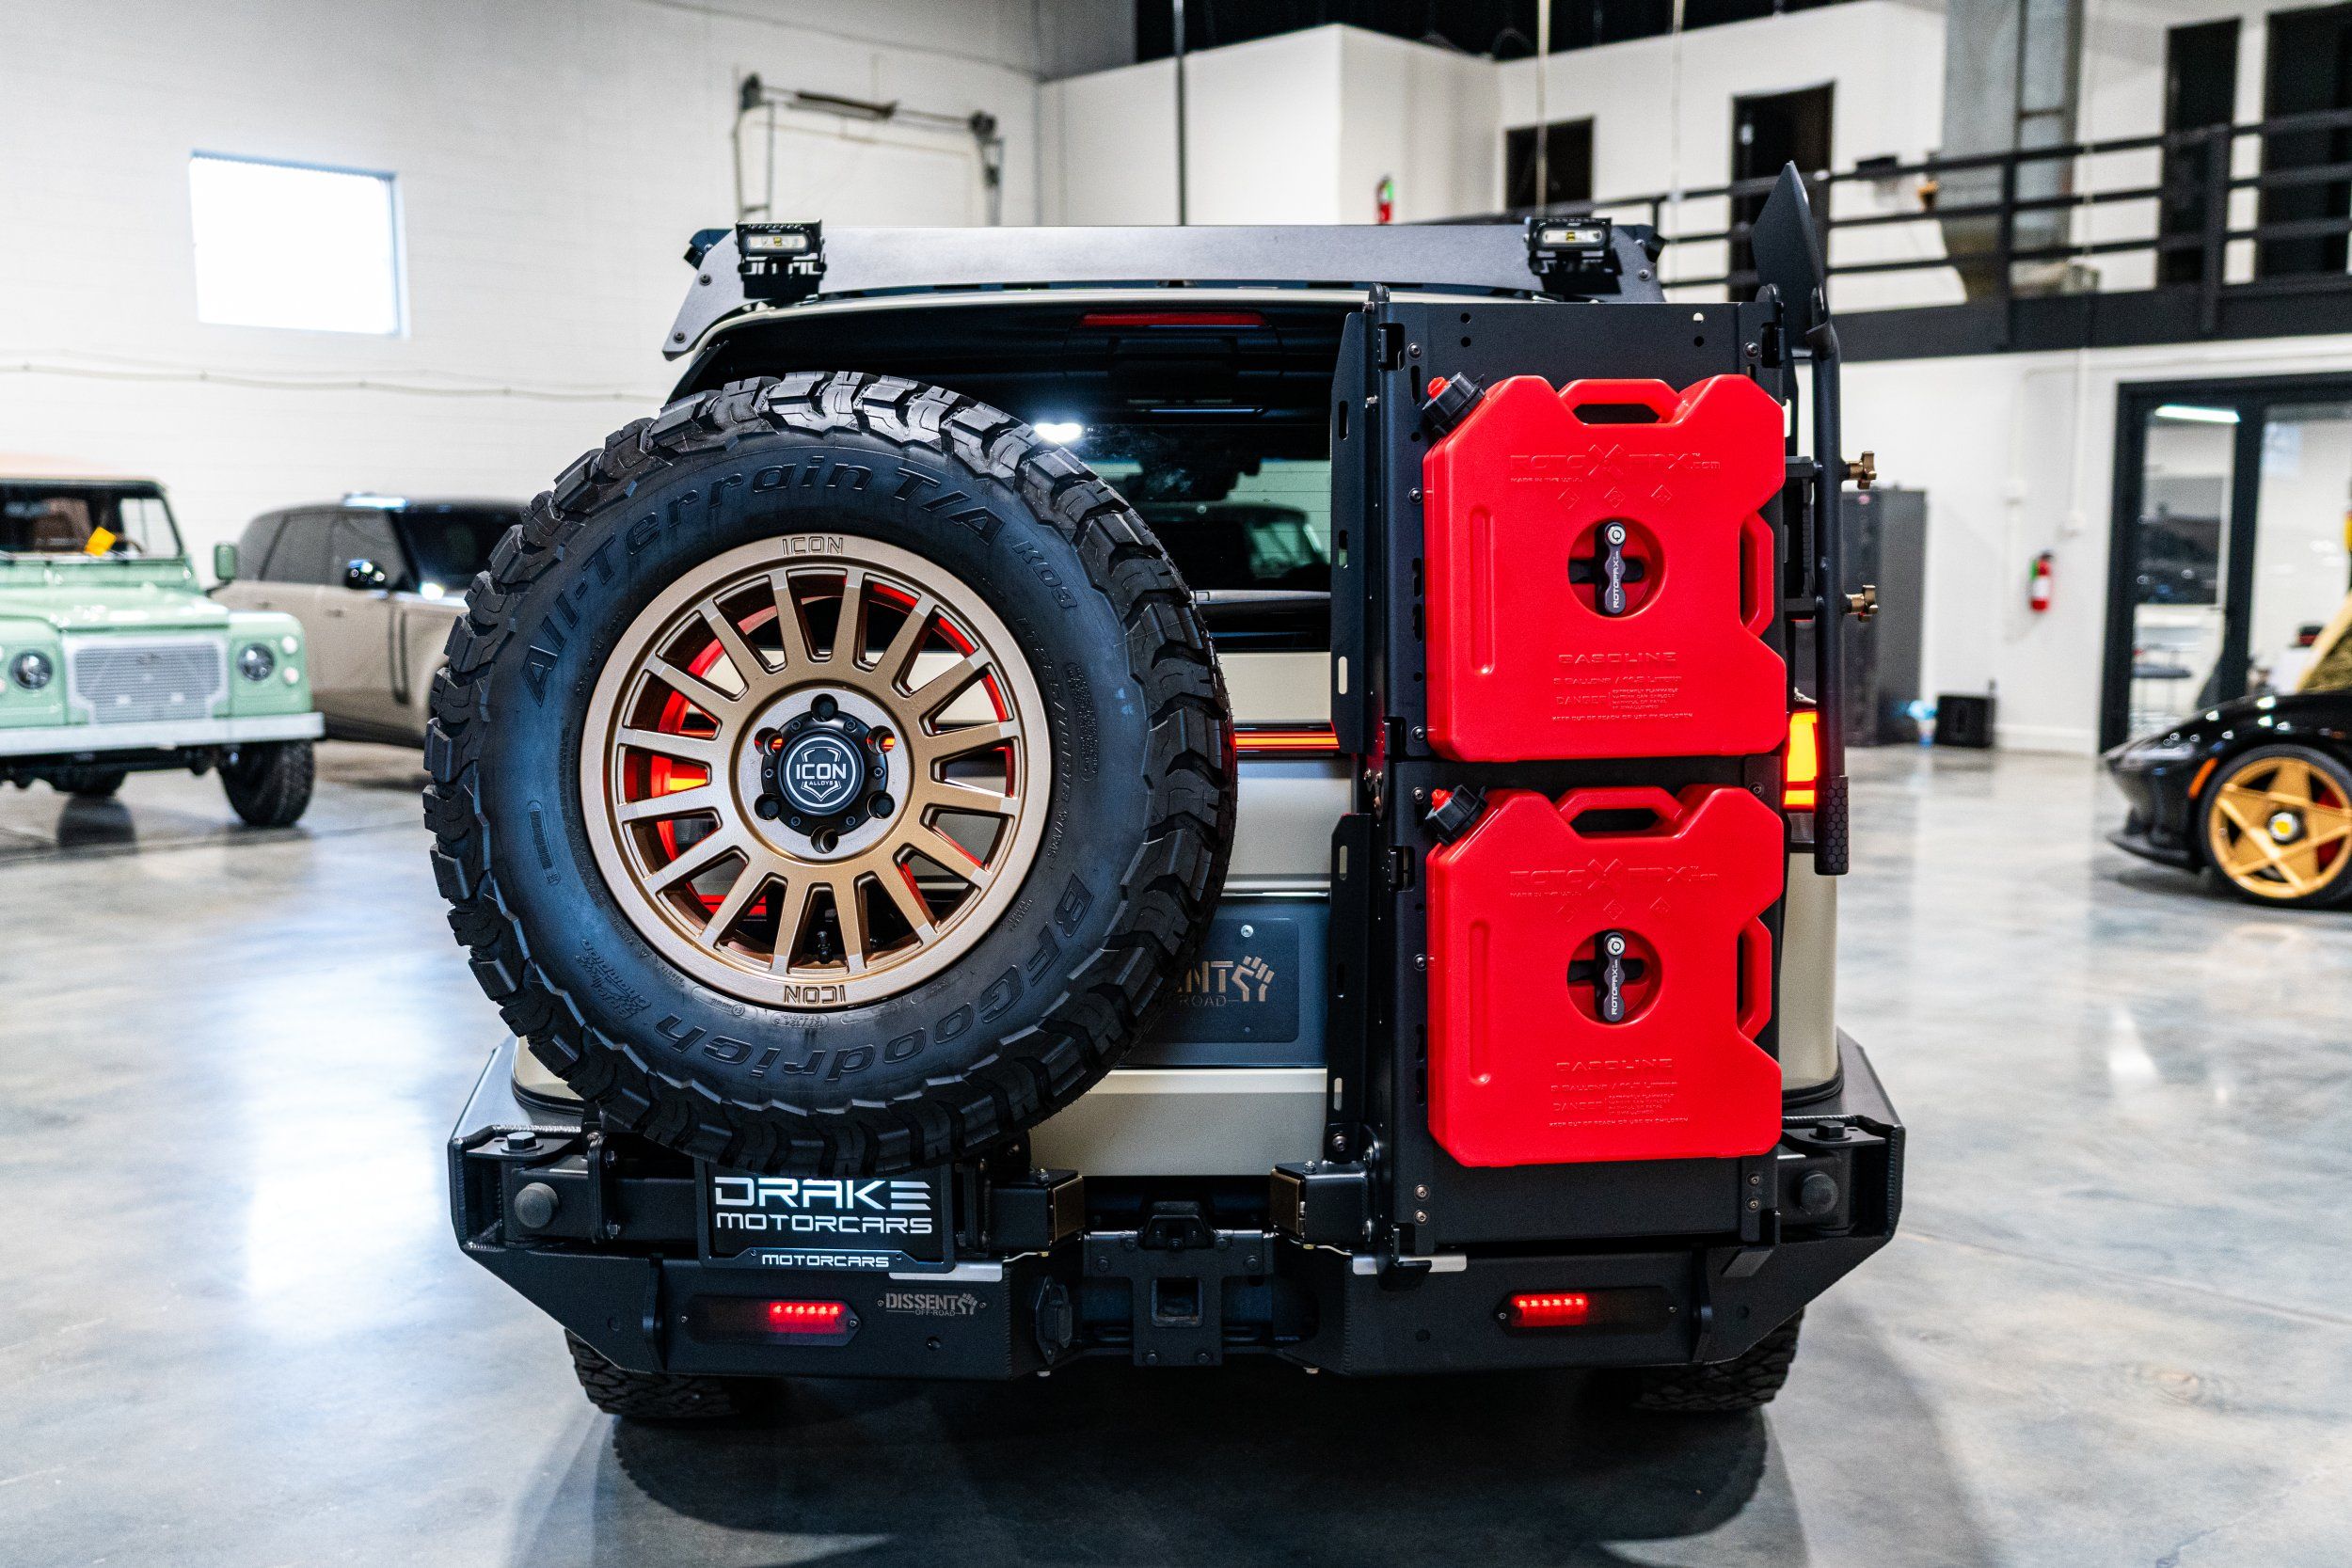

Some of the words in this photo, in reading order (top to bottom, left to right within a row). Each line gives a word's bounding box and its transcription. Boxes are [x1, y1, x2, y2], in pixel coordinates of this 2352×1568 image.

[782, 536, 843, 555] ICON
[517, 455, 876, 707] All-Terrain
[893, 466, 1008, 546] T/A
[1558, 651, 1677, 664] GASOLINE
[796, 763, 847, 780] ICON
[648, 871, 1095, 1082] BFGoodrich
[784, 985, 846, 1005] ICON
[1556, 1058, 1673, 1071] GASOLINE
[715, 1177, 931, 1211] DRAKE
[716, 1212, 932, 1234] MOTORCARS
[762, 1254, 889, 1267] MOTORCARS
[885, 1292, 958, 1311] DISSENT
[914, 1308, 956, 1317] OFF-ROAD
